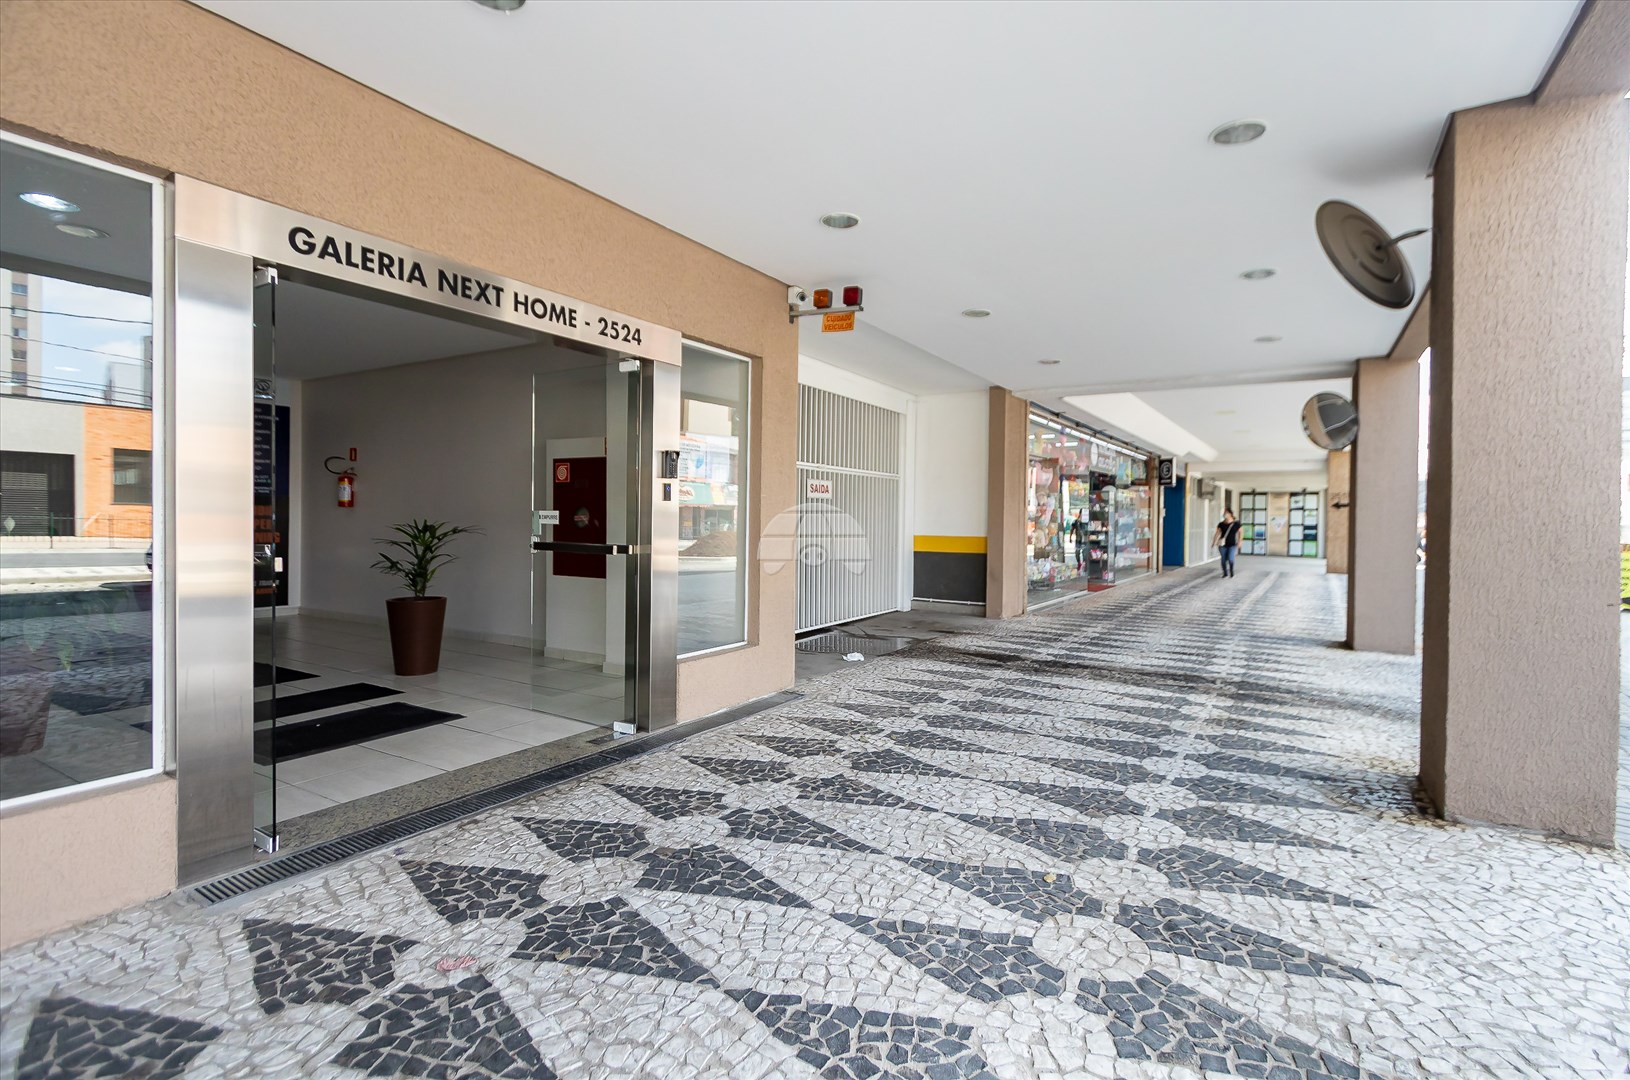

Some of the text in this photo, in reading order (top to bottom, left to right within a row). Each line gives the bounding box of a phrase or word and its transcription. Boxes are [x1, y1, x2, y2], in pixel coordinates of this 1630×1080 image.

[288, 226, 428, 288] GALERIA
[437, 268, 504, 308] NEXT
[513, 291, 577, 328] HOME
[597, 317, 642, 346] 2524
[826, 314, 852, 322] CUIDADO
